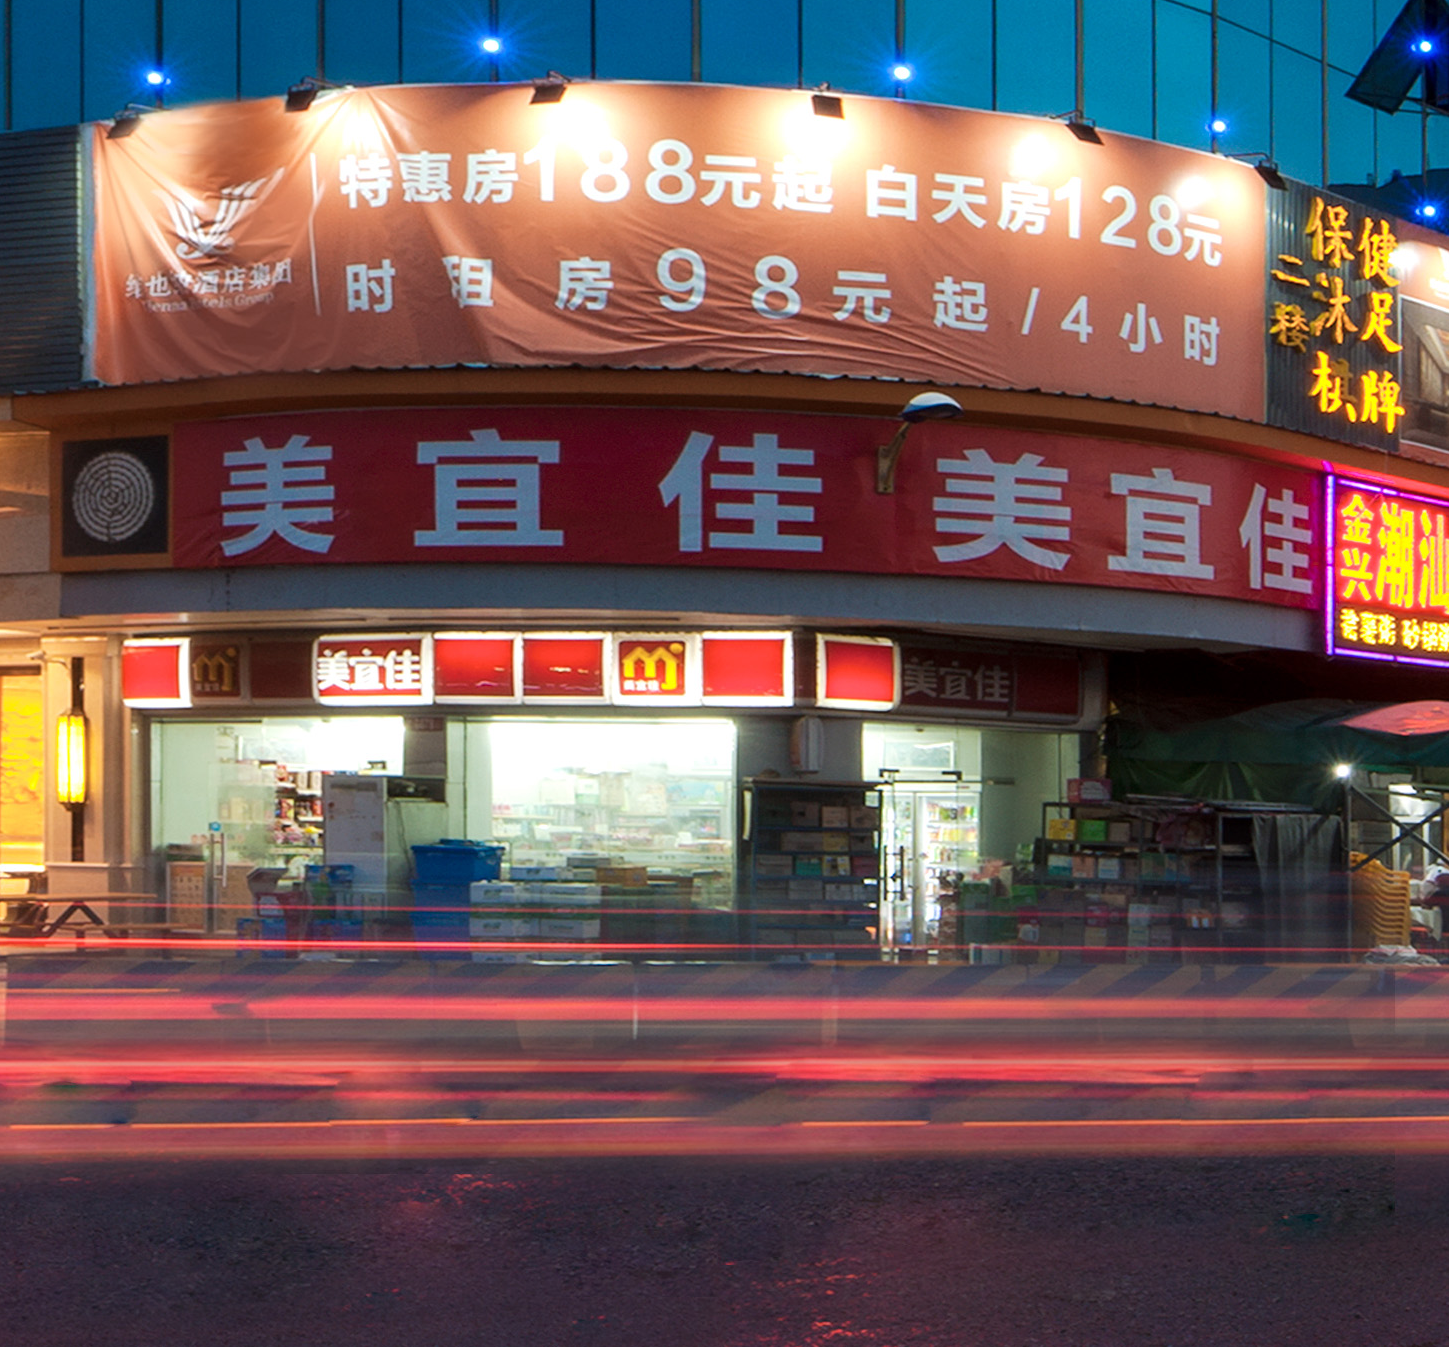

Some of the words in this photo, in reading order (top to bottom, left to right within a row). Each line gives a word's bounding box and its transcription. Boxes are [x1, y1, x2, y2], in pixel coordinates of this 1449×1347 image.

[338, 137, 834, 213] 特惠房188元起
[865, 164, 1224, 267] 白天房128元
[220, 428, 825, 558] 美宜佳
[928, 447, 1315, 597] 美宜佳
[316, 648, 423, 692] 美宜佳
[903, 656, 1011, 703] 美宜佳
